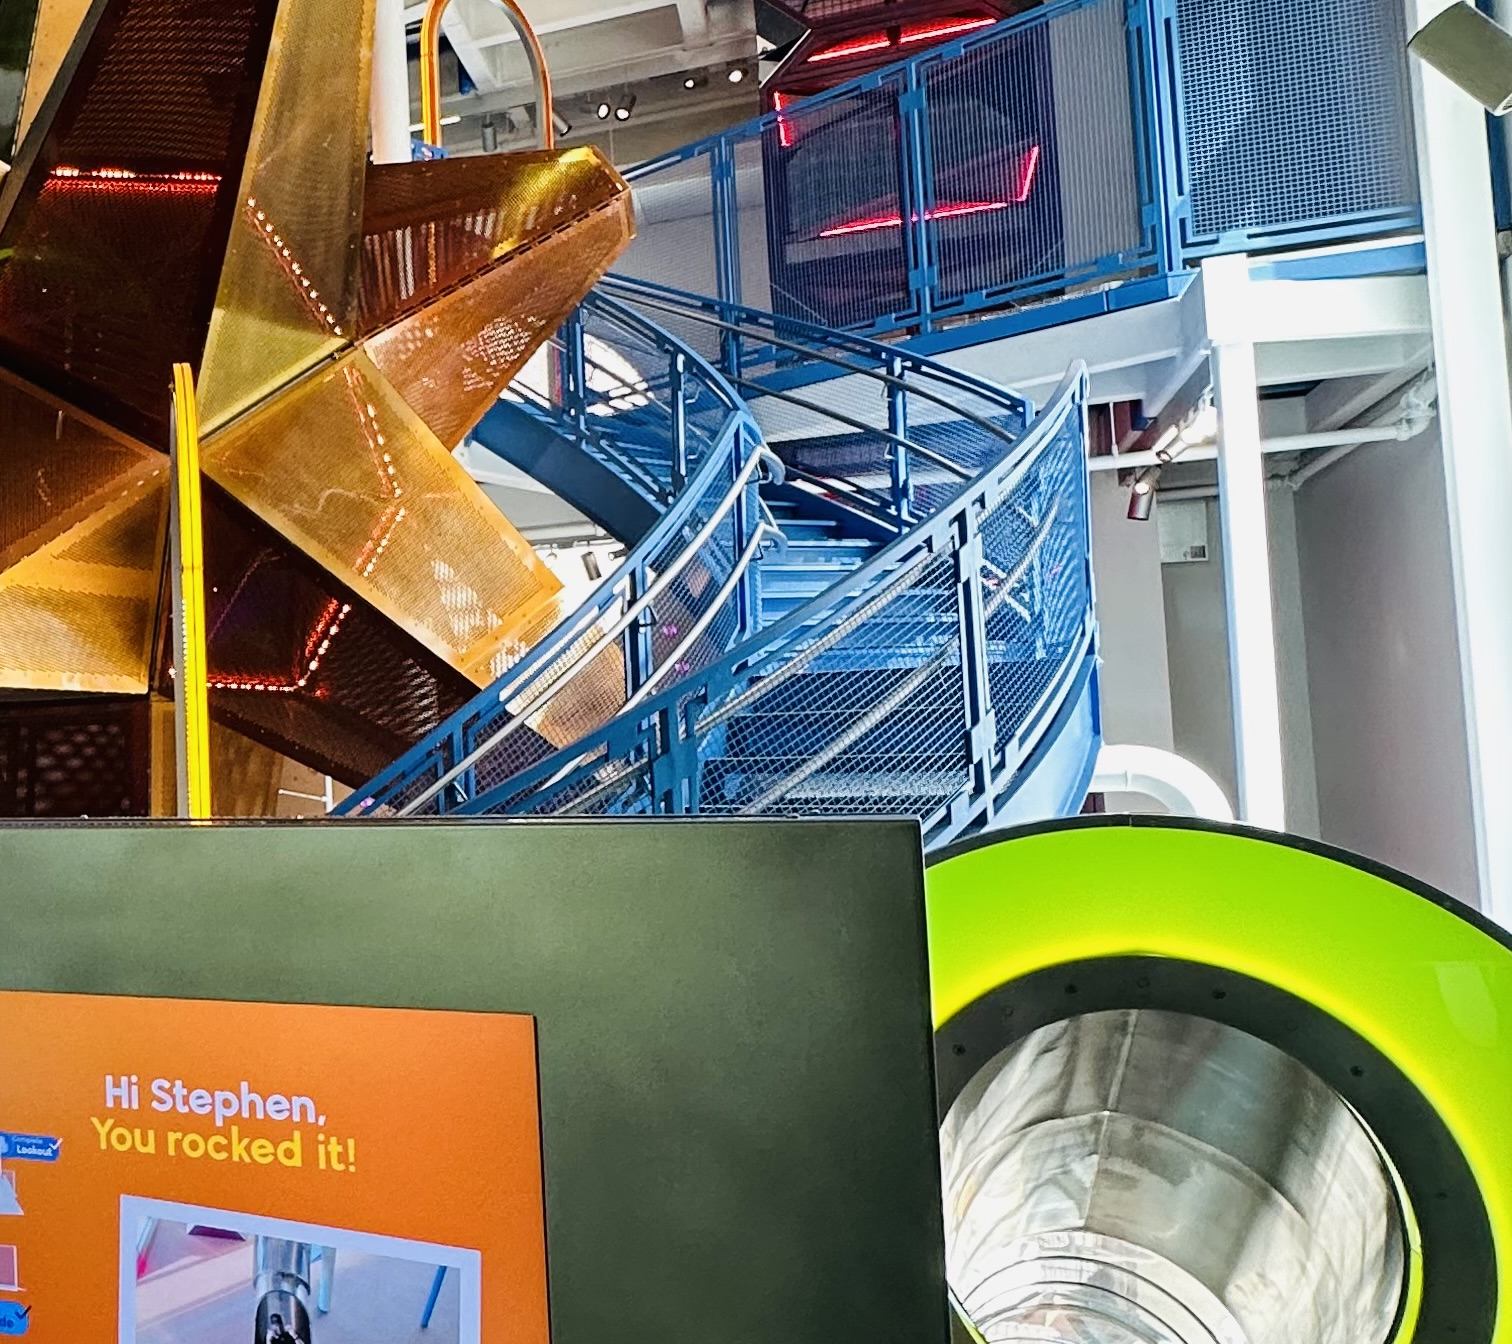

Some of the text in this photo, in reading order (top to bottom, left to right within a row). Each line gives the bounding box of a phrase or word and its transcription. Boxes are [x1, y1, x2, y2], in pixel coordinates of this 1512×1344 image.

[105, 1075, 327, 1127] Hi Stephen,
[16, 1144, 53, 1157] Lookout
[91, 1117, 356, 1173] You rocked it!
